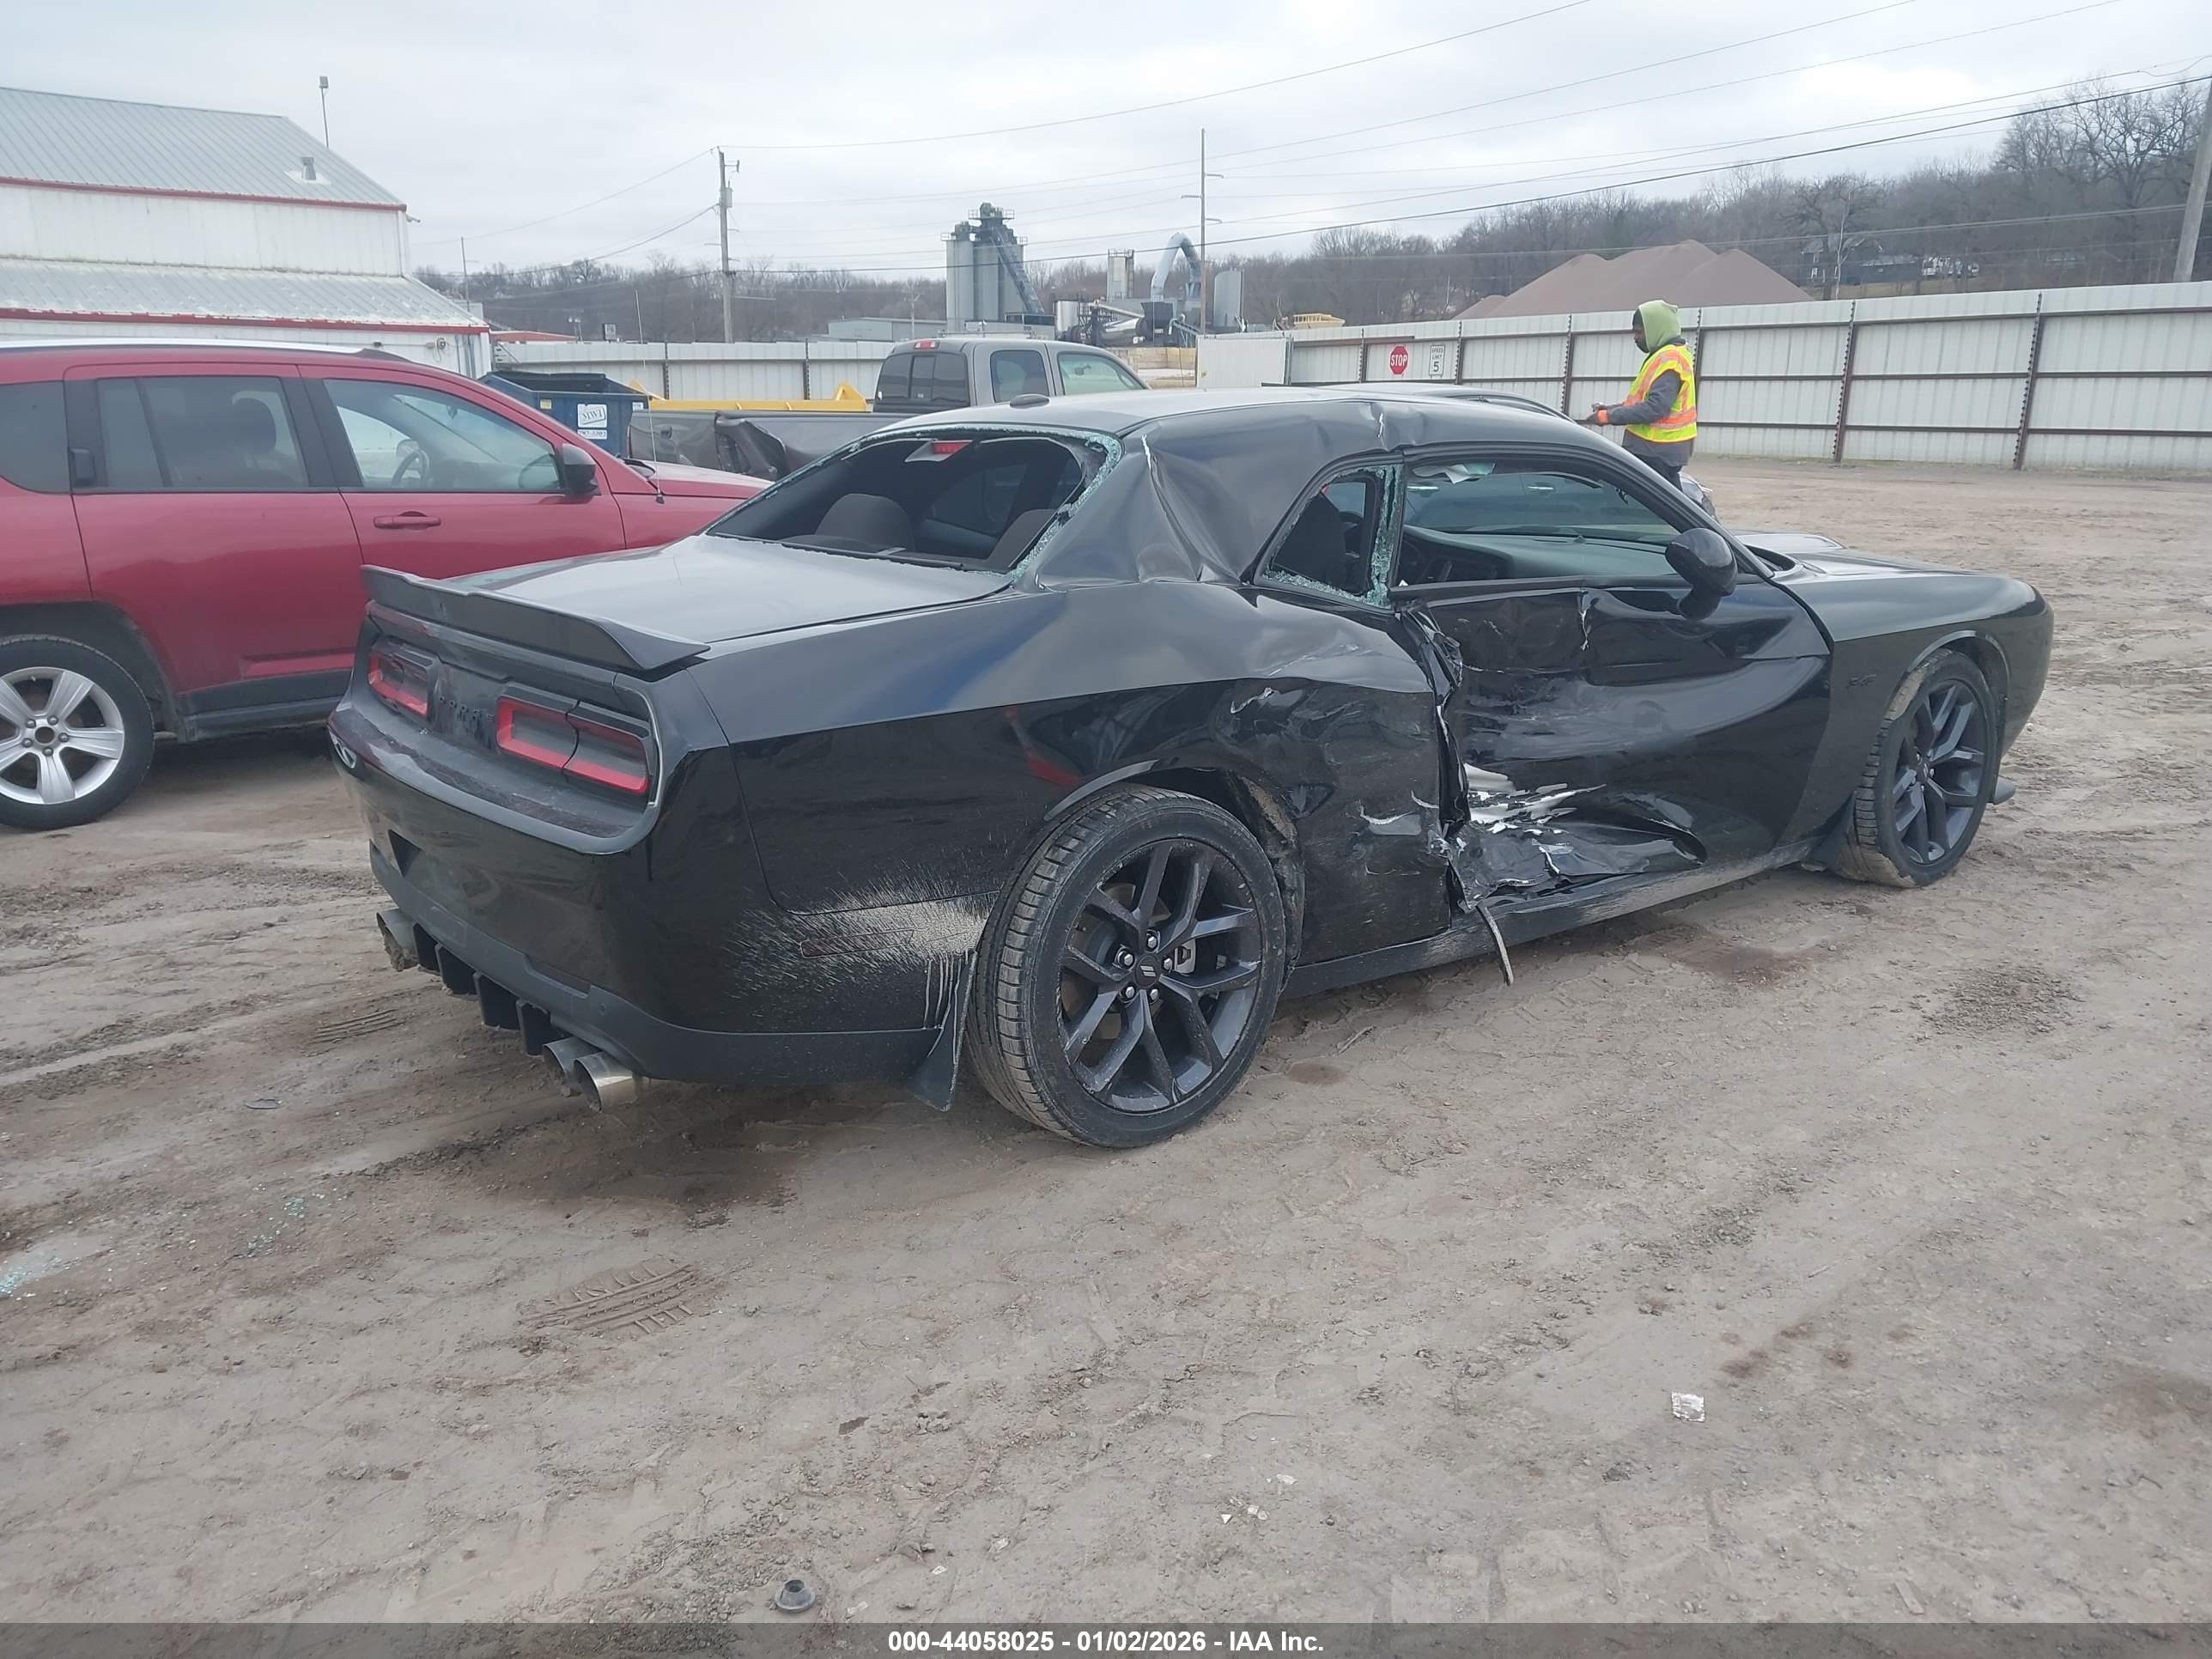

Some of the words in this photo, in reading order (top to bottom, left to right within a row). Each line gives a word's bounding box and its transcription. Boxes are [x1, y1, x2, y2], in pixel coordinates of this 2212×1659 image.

[1391, 354, 1407, 367] STOP
[1433, 362, 1440, 372] 5
[440, 696, 495, 721] DODGE
